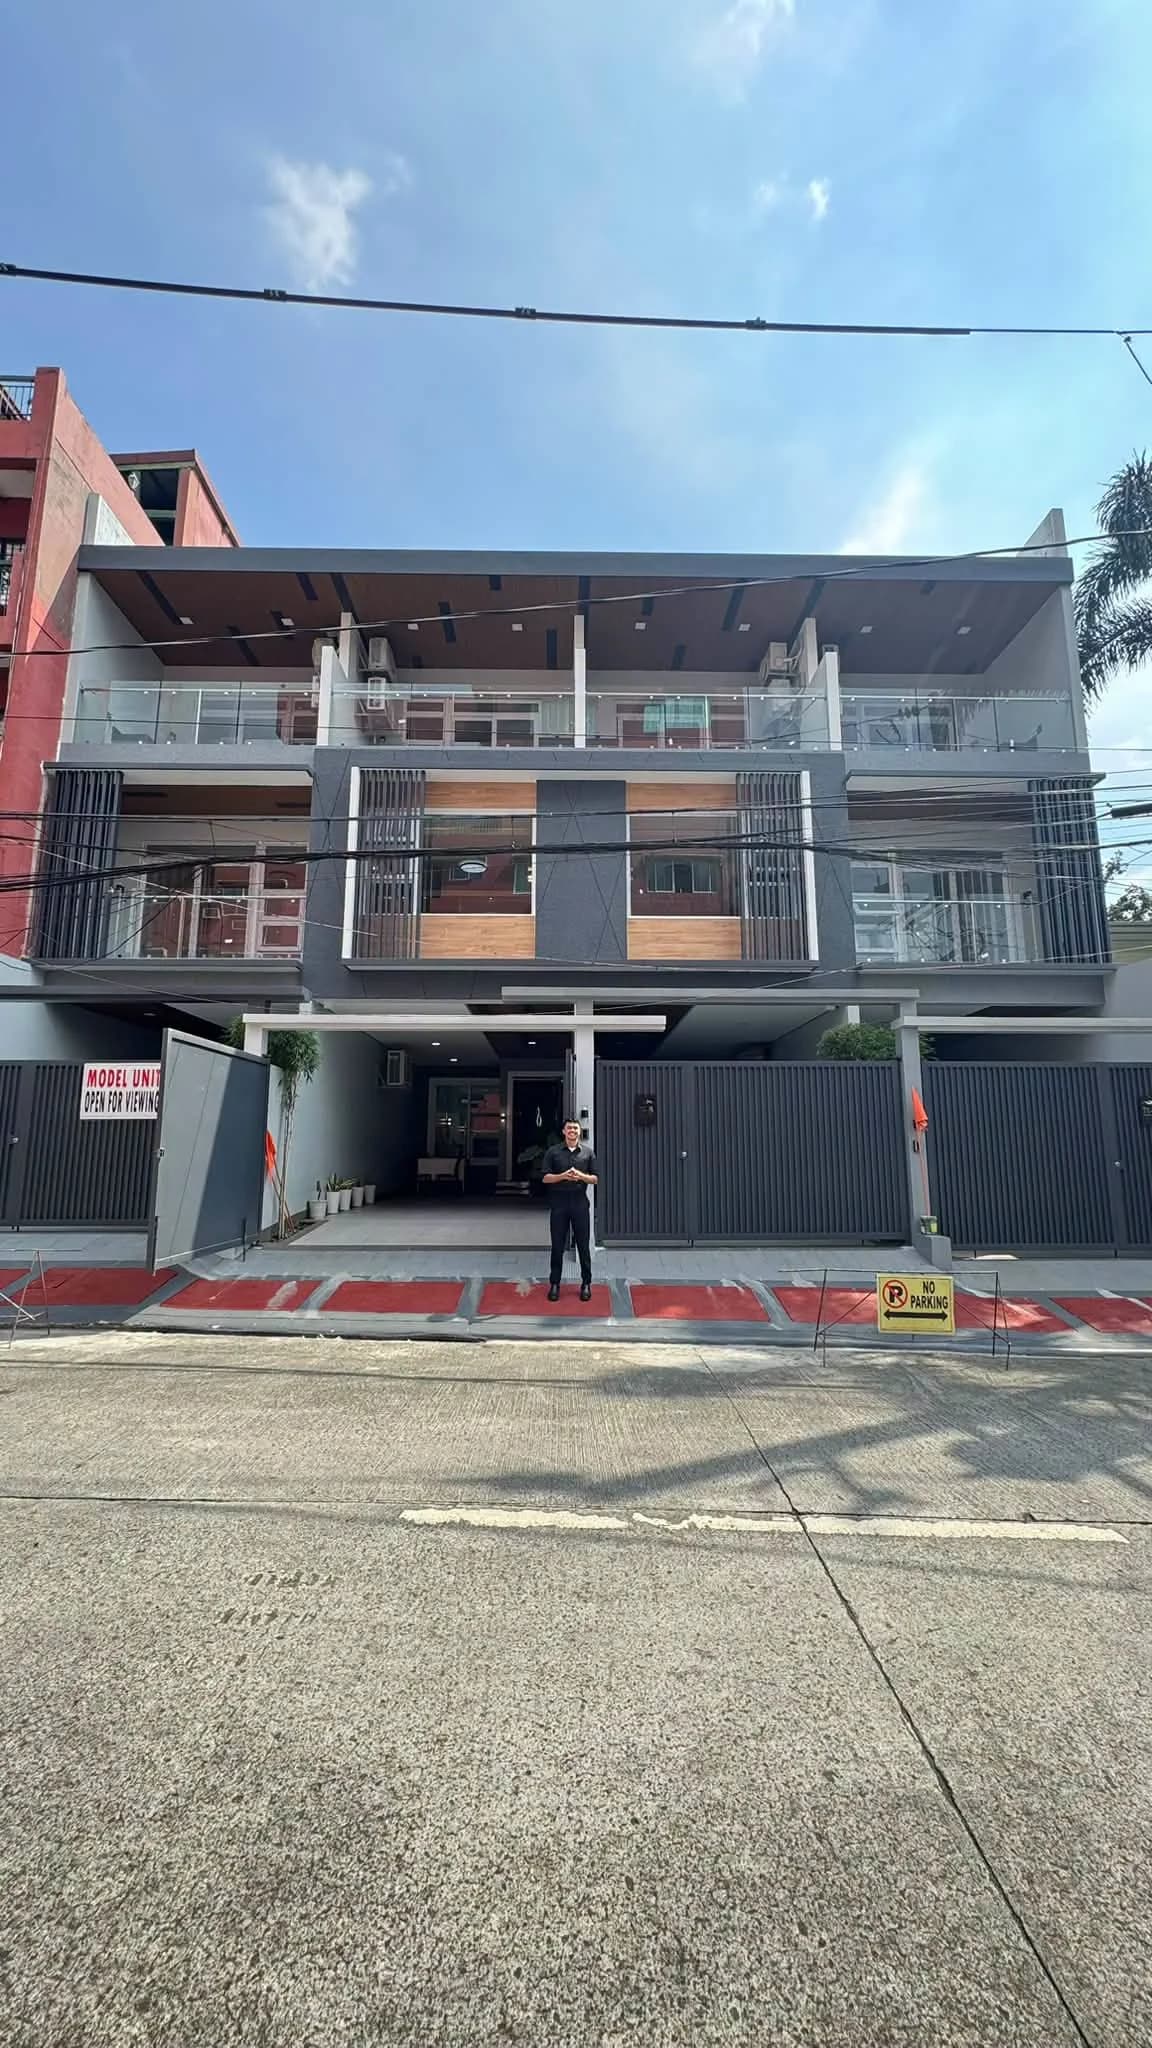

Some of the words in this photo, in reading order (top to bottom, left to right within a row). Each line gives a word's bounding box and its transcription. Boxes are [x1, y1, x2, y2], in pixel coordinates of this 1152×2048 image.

[87, 1069, 127, 1088] MODEL
[85, 1091, 105, 1112] OPEN
[108, 1091, 123, 1112] FOR
[125, 1091, 160, 1112] VIEWING
[922, 1281, 936, 1294] NO
[910, 1296, 949, 1309] PARKING
